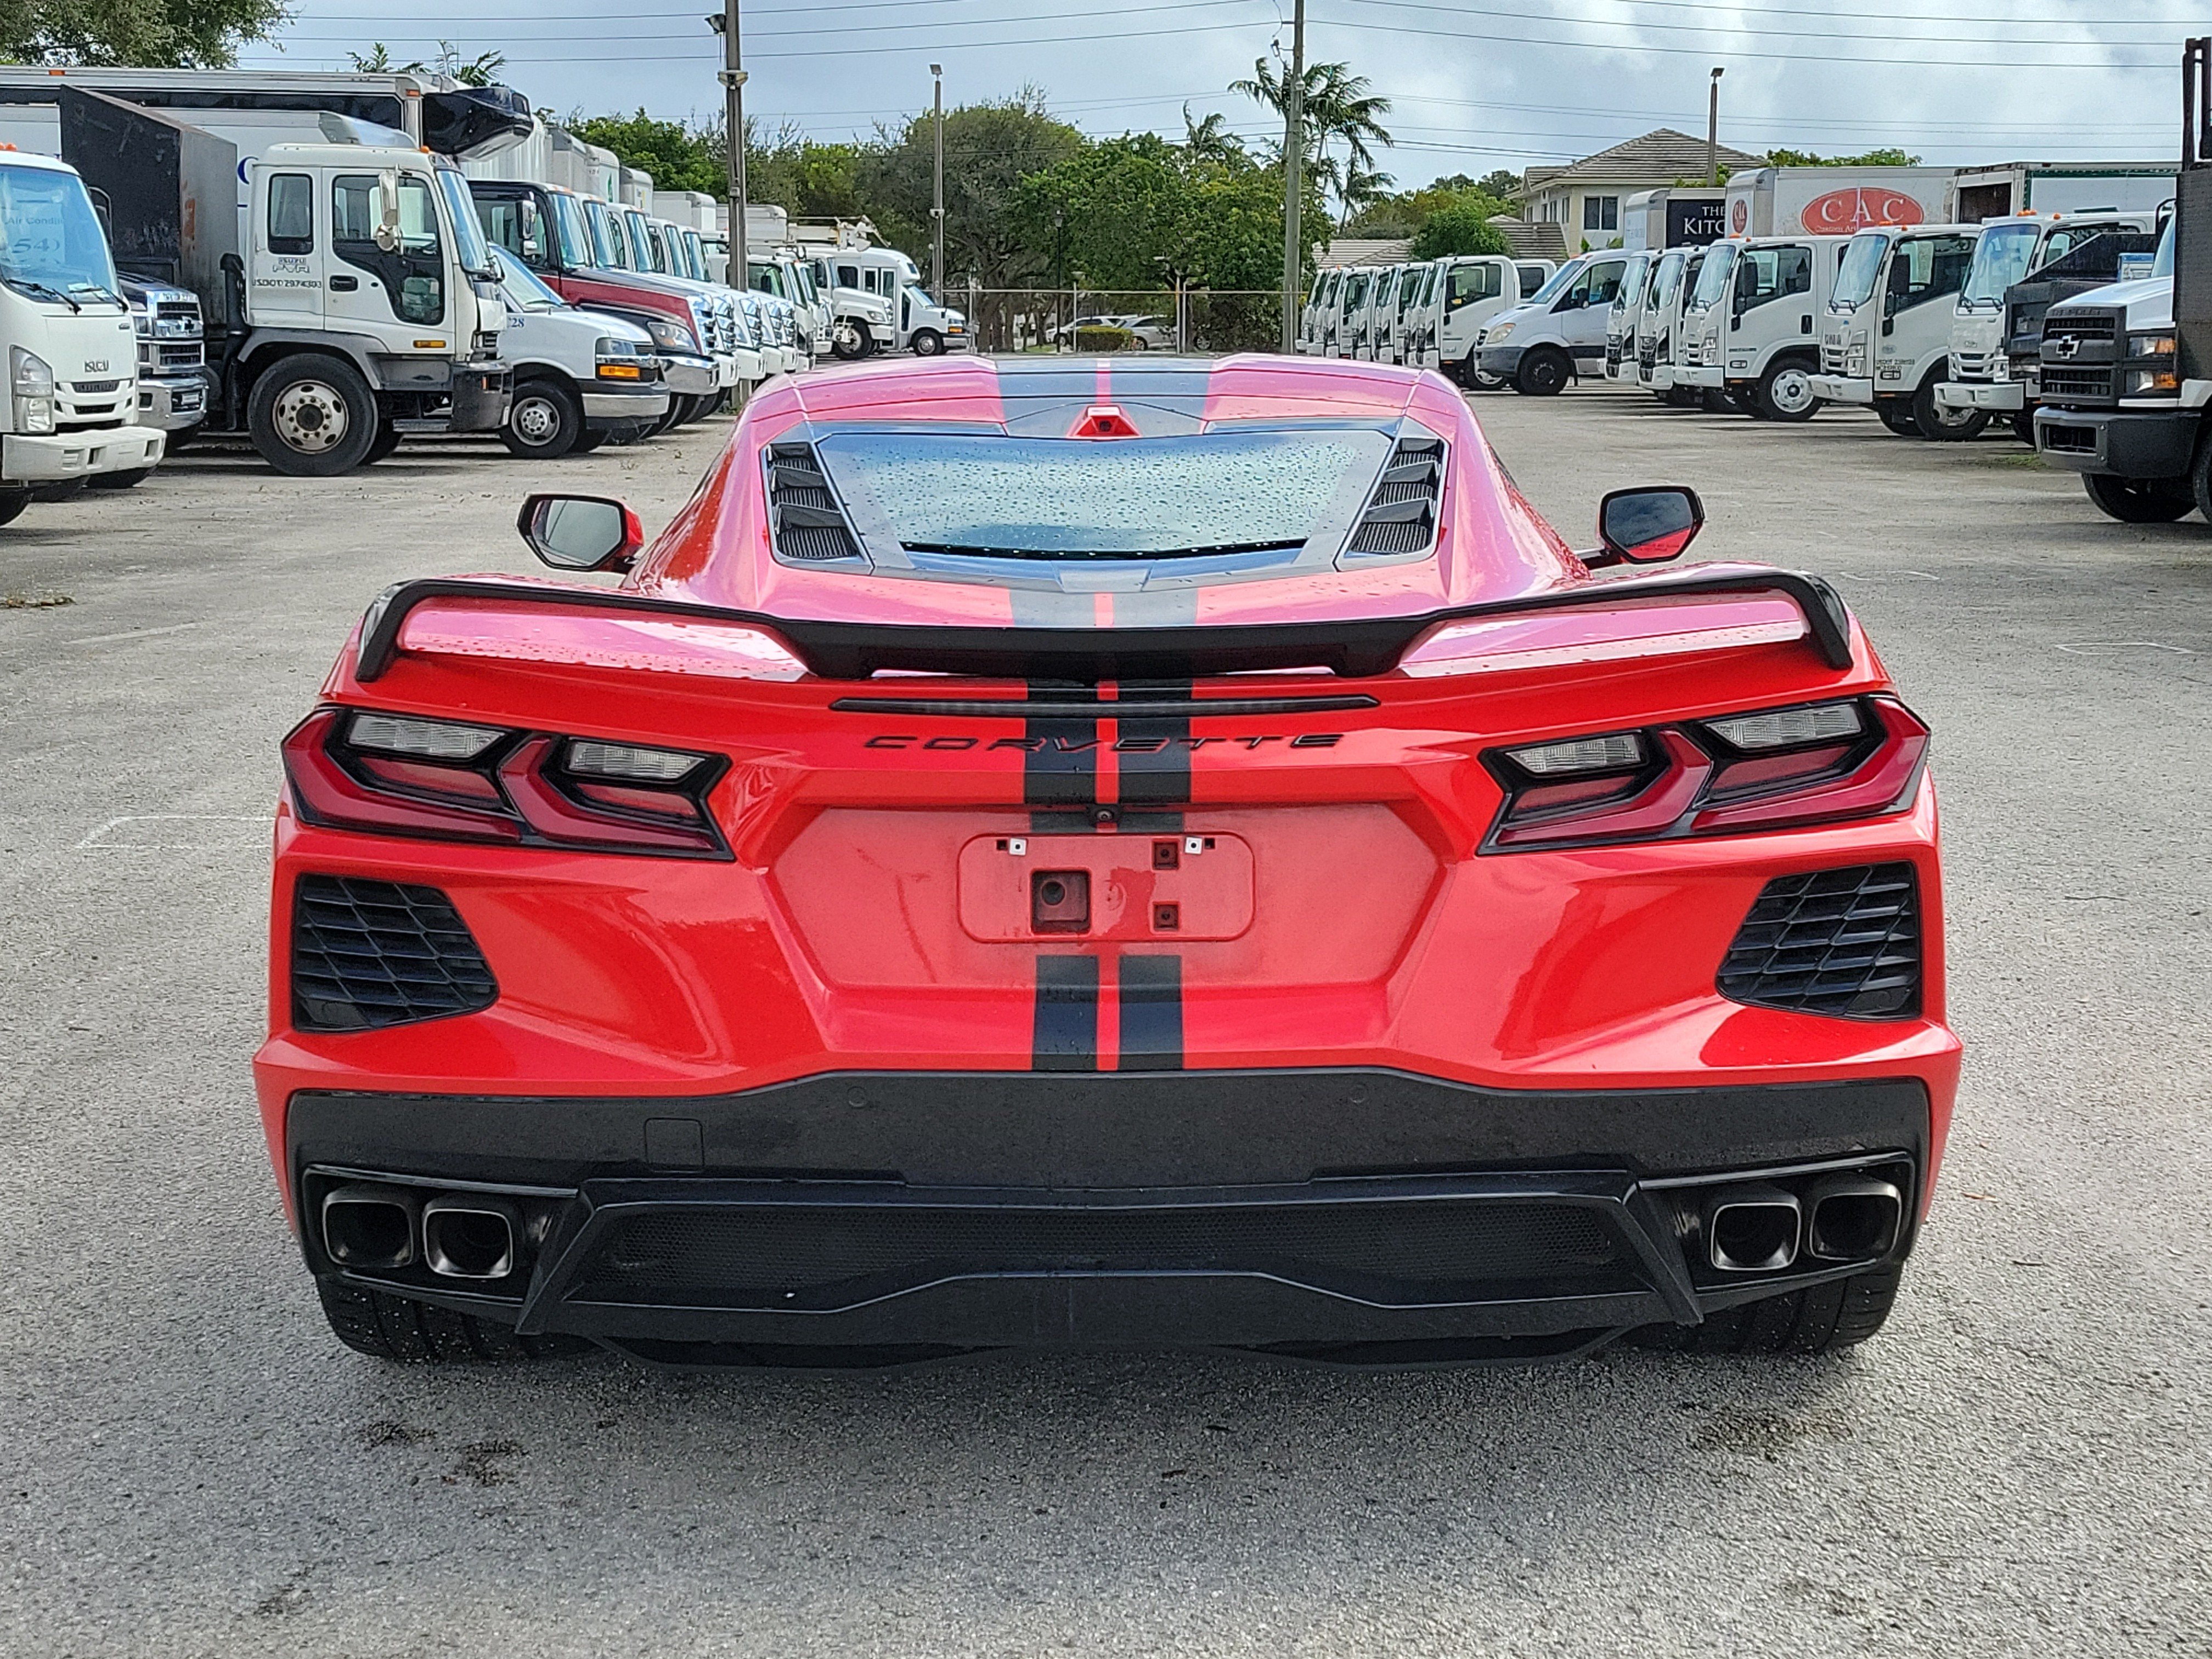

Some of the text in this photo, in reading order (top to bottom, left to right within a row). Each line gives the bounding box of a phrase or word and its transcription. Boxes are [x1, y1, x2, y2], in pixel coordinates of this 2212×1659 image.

[1702, 206, 1725, 216] THE
[1821, 199, 1906, 222] CAC
[507, 318, 524, 328] 28
[864, 732, 1346, 753] CORVETTE
